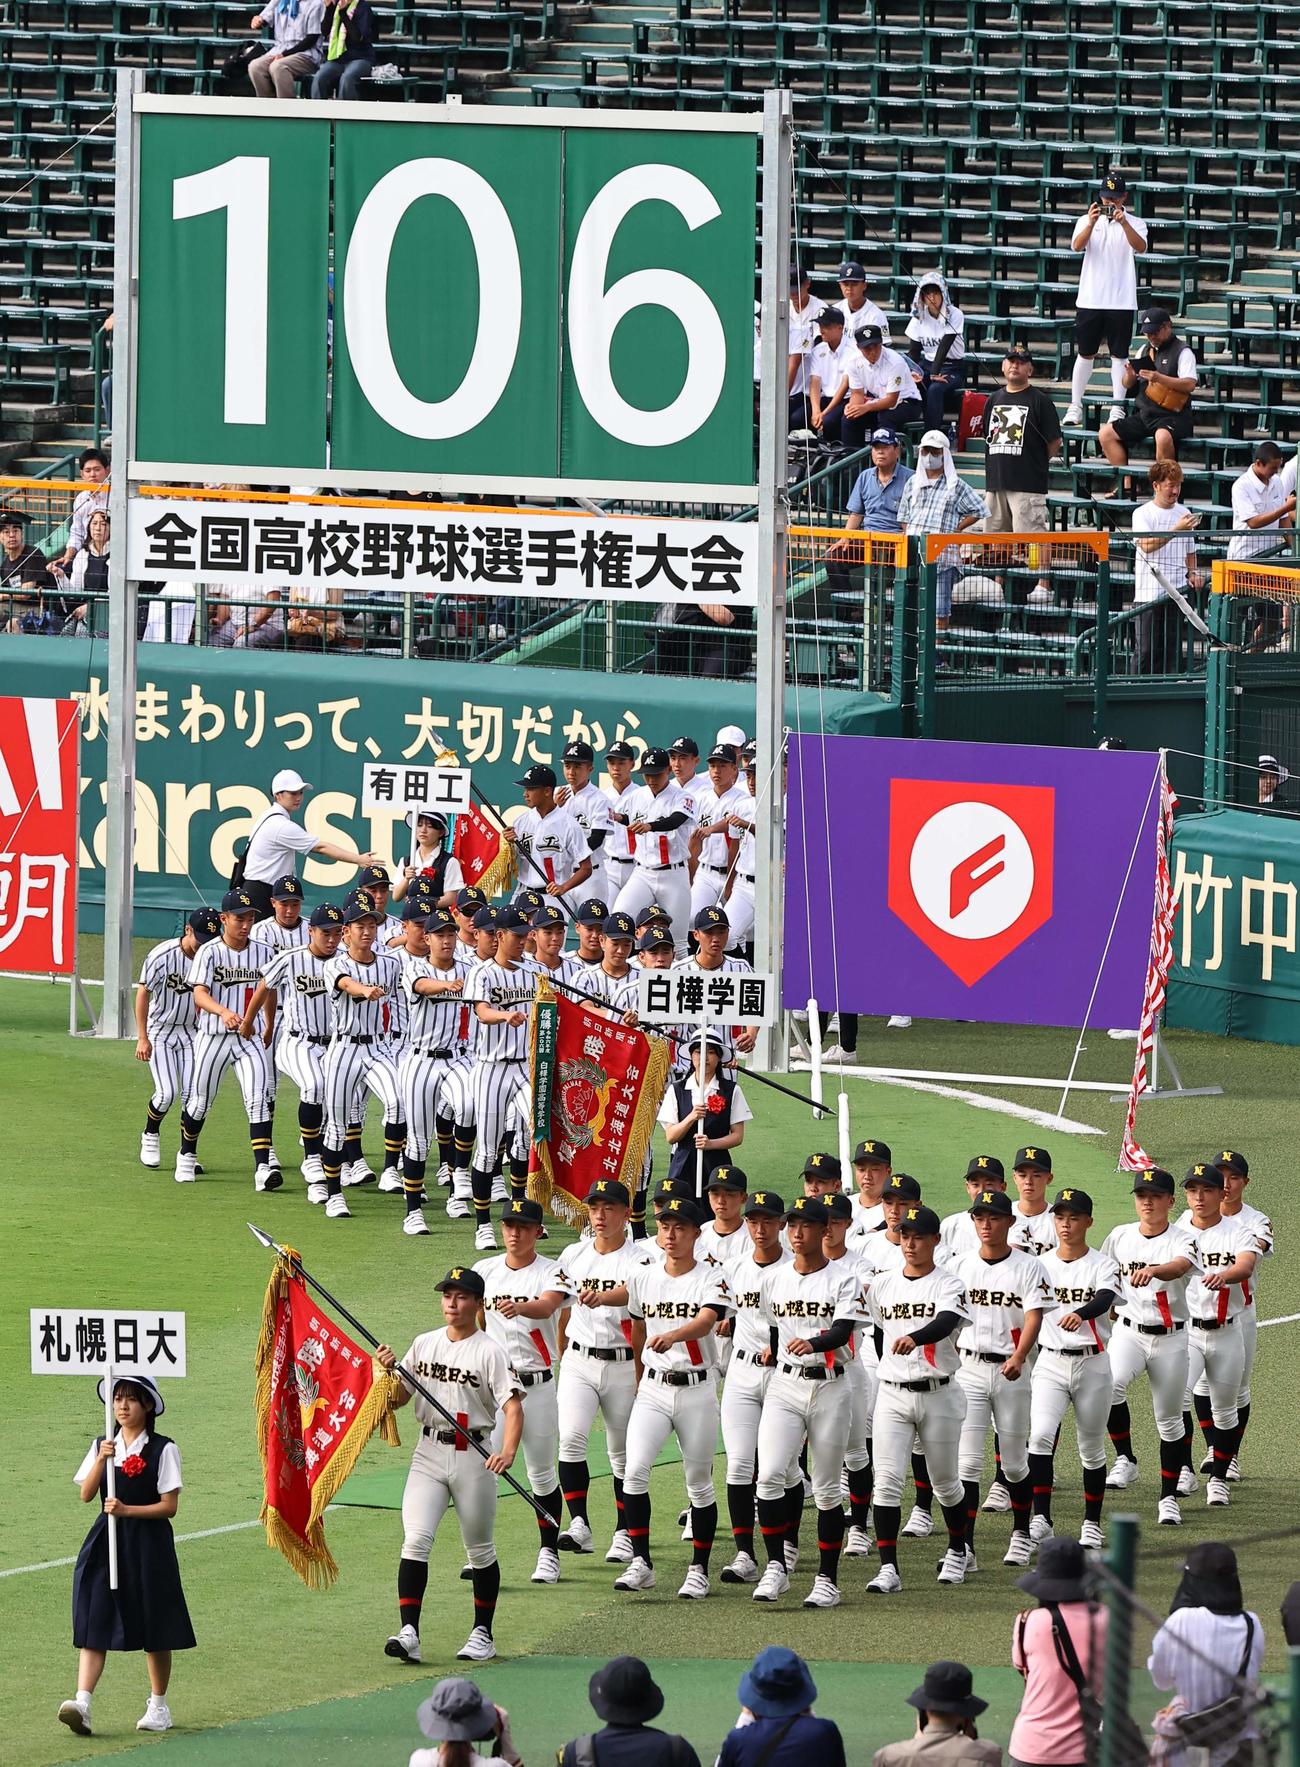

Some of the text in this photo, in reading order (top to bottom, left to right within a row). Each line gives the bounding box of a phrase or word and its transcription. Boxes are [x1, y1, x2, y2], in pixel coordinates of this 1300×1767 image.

[172, 155, 727, 448] 106
[145, 512, 744, 594] 全国高校野球選手権大会
[370, 768, 463, 803] 有田工
[372, 868, 383, 878] SG
[285, 882, 295, 893] SG
[420, 883, 430, 893] SG
[467, 888, 478, 898] SG
[240, 895, 250, 905] SG
[528, 895, 539, 905] SG
[420, 903, 430, 913] SG
[547, 908, 558, 918] SG
[591, 906, 601, 916] SG
[328, 910, 338, 920] SG
[438, 912, 449, 922] SG
[709, 911, 720, 921] SG
[1176, 850, 1298, 981] 竹中
[618, 919, 629, 931] SG
[653, 929, 664, 939] SG
[647, 975, 765, 1017] 白樺学園
[602, 1064, 640, 1174] 北北海道大会
[864, 1143, 875, 1153] N
[1026, 1149, 1037, 1160] N
[1222, 1152, 1233, 1161] N
[812, 1155, 823, 1166] N
[978, 1158, 989, 1168] N
[717, 1169, 729, 1180] N
[1143, 1171, 1154, 1181] N
[1194, 1166, 1205, 1176] N
[597, 1181, 608, 1191] N
[662, 1180, 673, 1191] N
[891, 1176, 903, 1188] N
[754, 1194, 766, 1204] N
[983, 1193, 994, 1203] N
[1062, 1190, 1074, 1200] N
[669, 1200, 681, 1211] N
[794, 1199, 806, 1209] N
[823, 1195, 835, 1206] N
[513, 1201, 524, 1212] N
[907, 1209, 919, 1220] N
[1201, 1252, 1236, 1268] 日大
[450, 1269, 463, 1280] N
[40, 1315, 177, 1364] 札幌日大
[414, 1361, 480, 1388] 札幌日大
